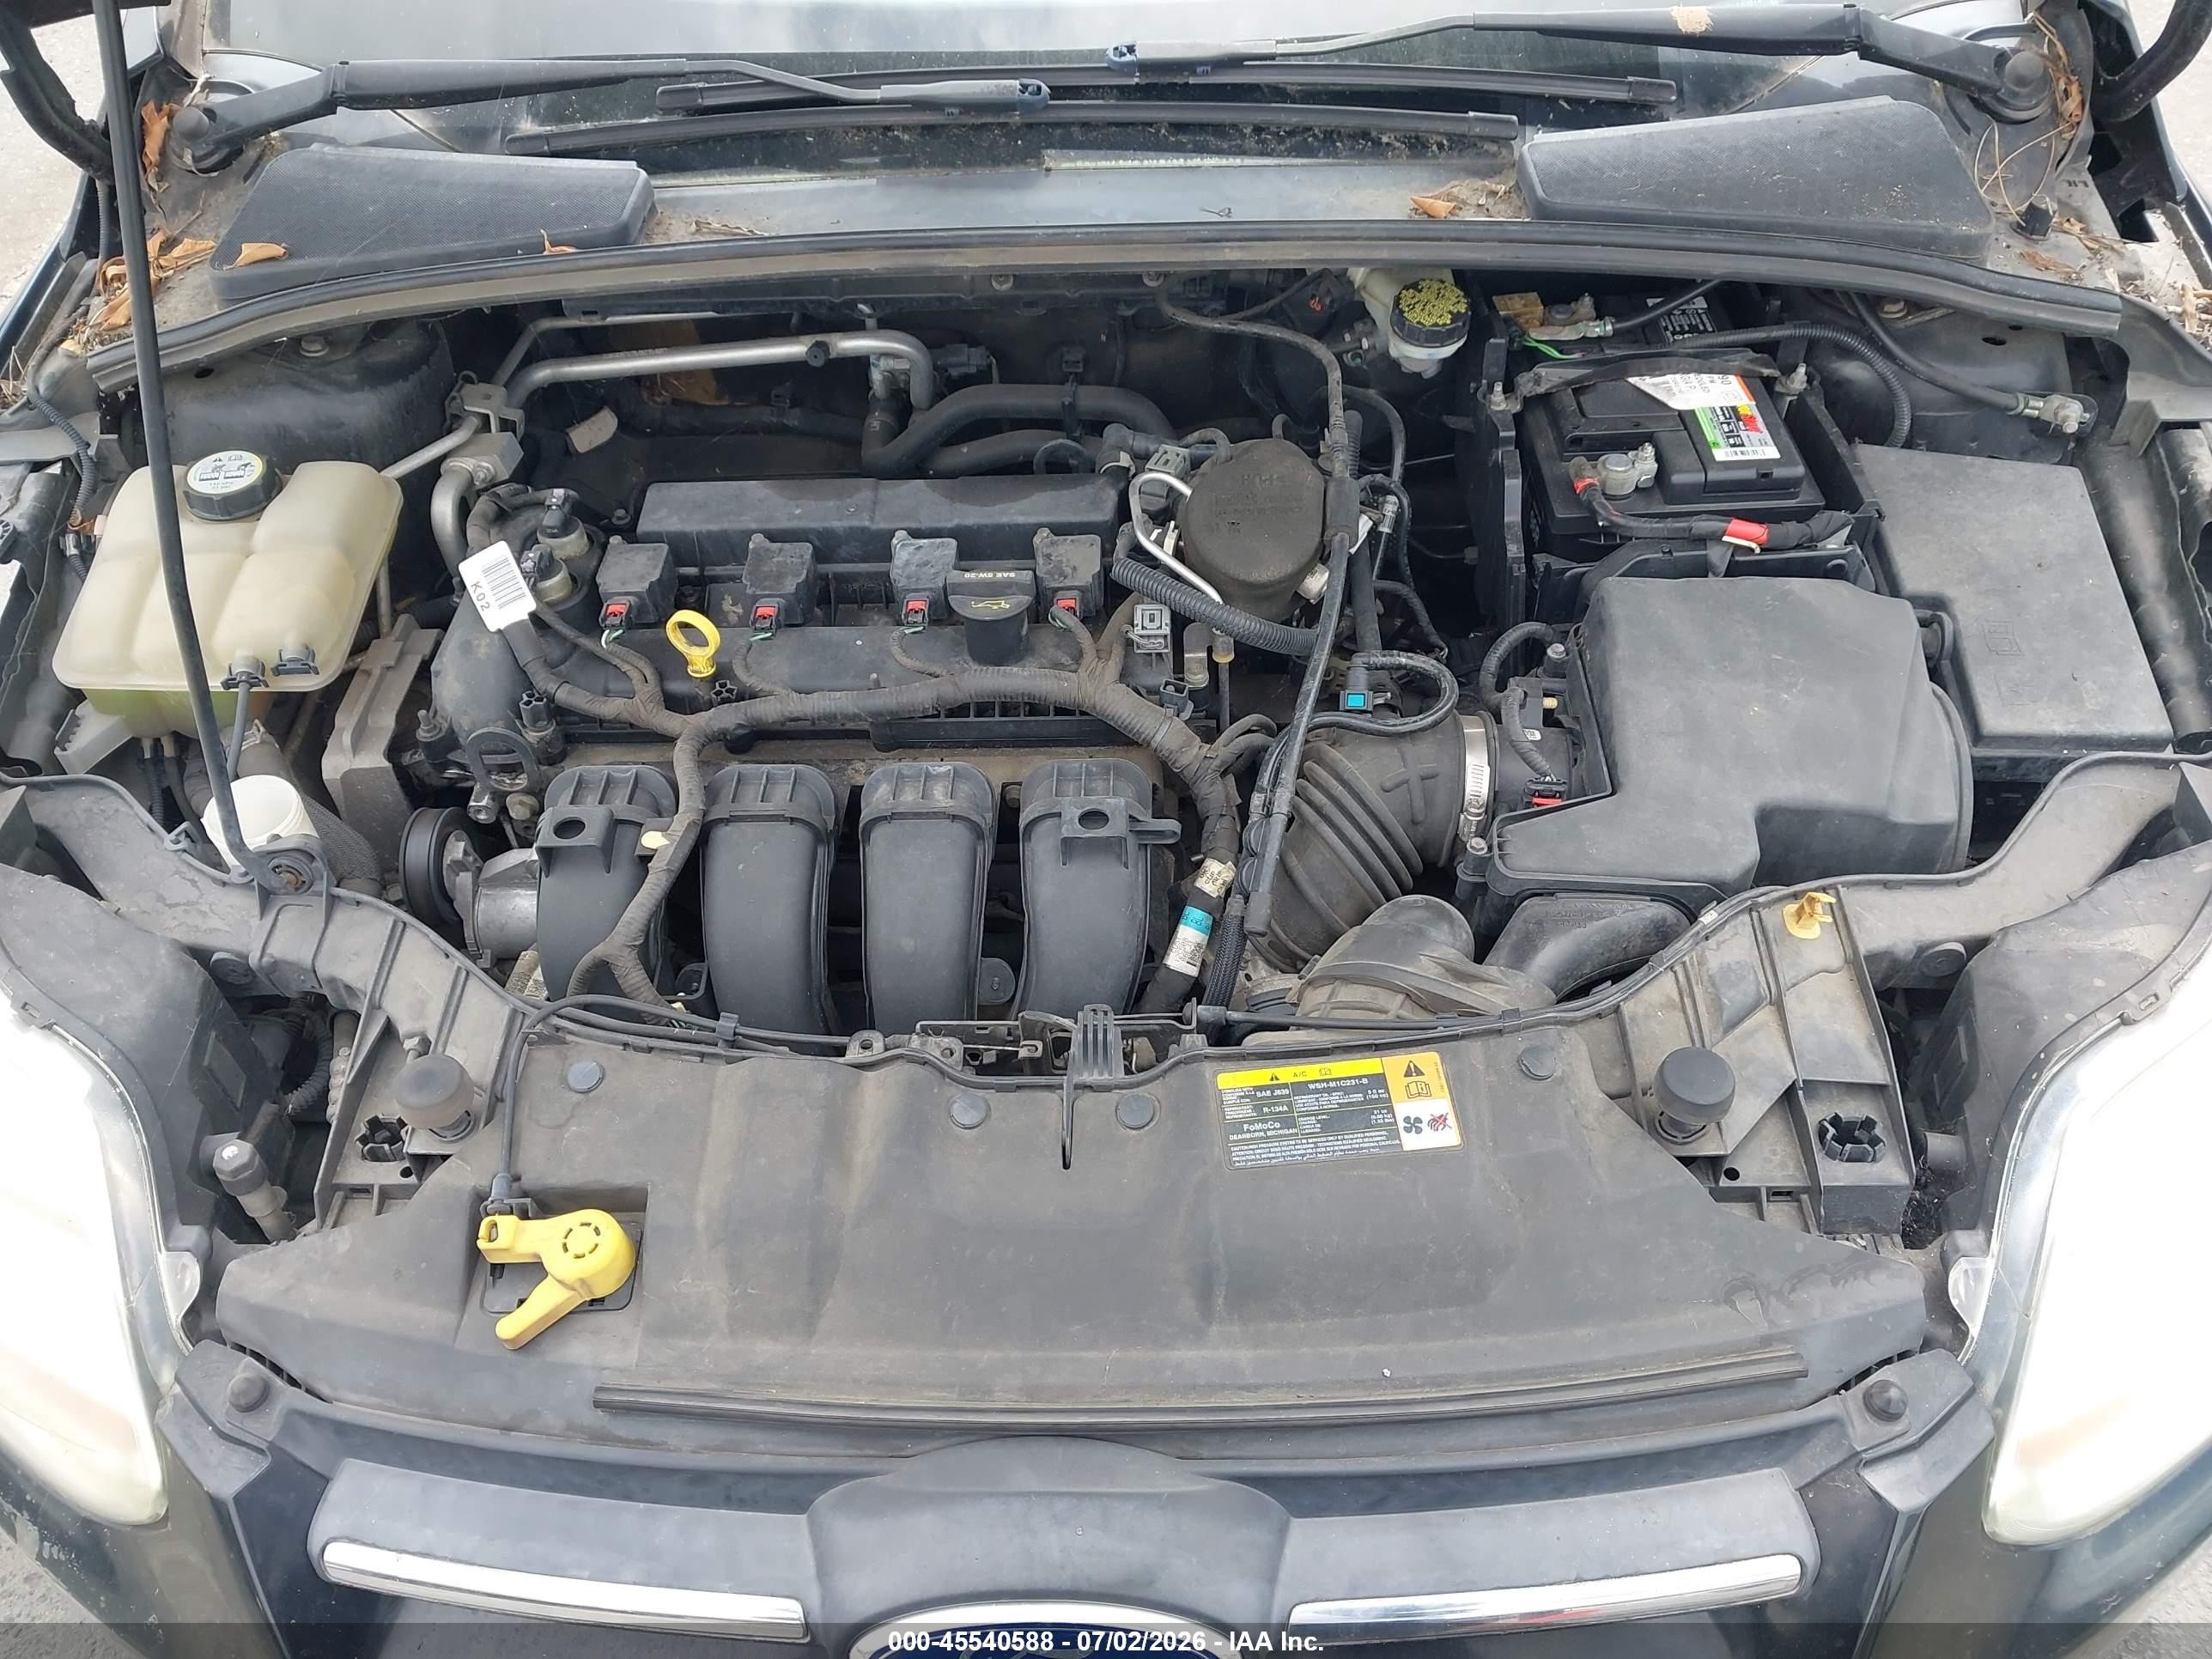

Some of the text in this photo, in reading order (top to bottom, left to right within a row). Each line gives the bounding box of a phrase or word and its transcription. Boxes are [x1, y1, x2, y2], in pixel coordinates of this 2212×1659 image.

[1308, 1078, 1368, 1089] WSH-M1C231-B
[1243, 1121, 1281, 1131] FoMoCo
[1229, 1132, 1266, 1141] DEARBORN,
